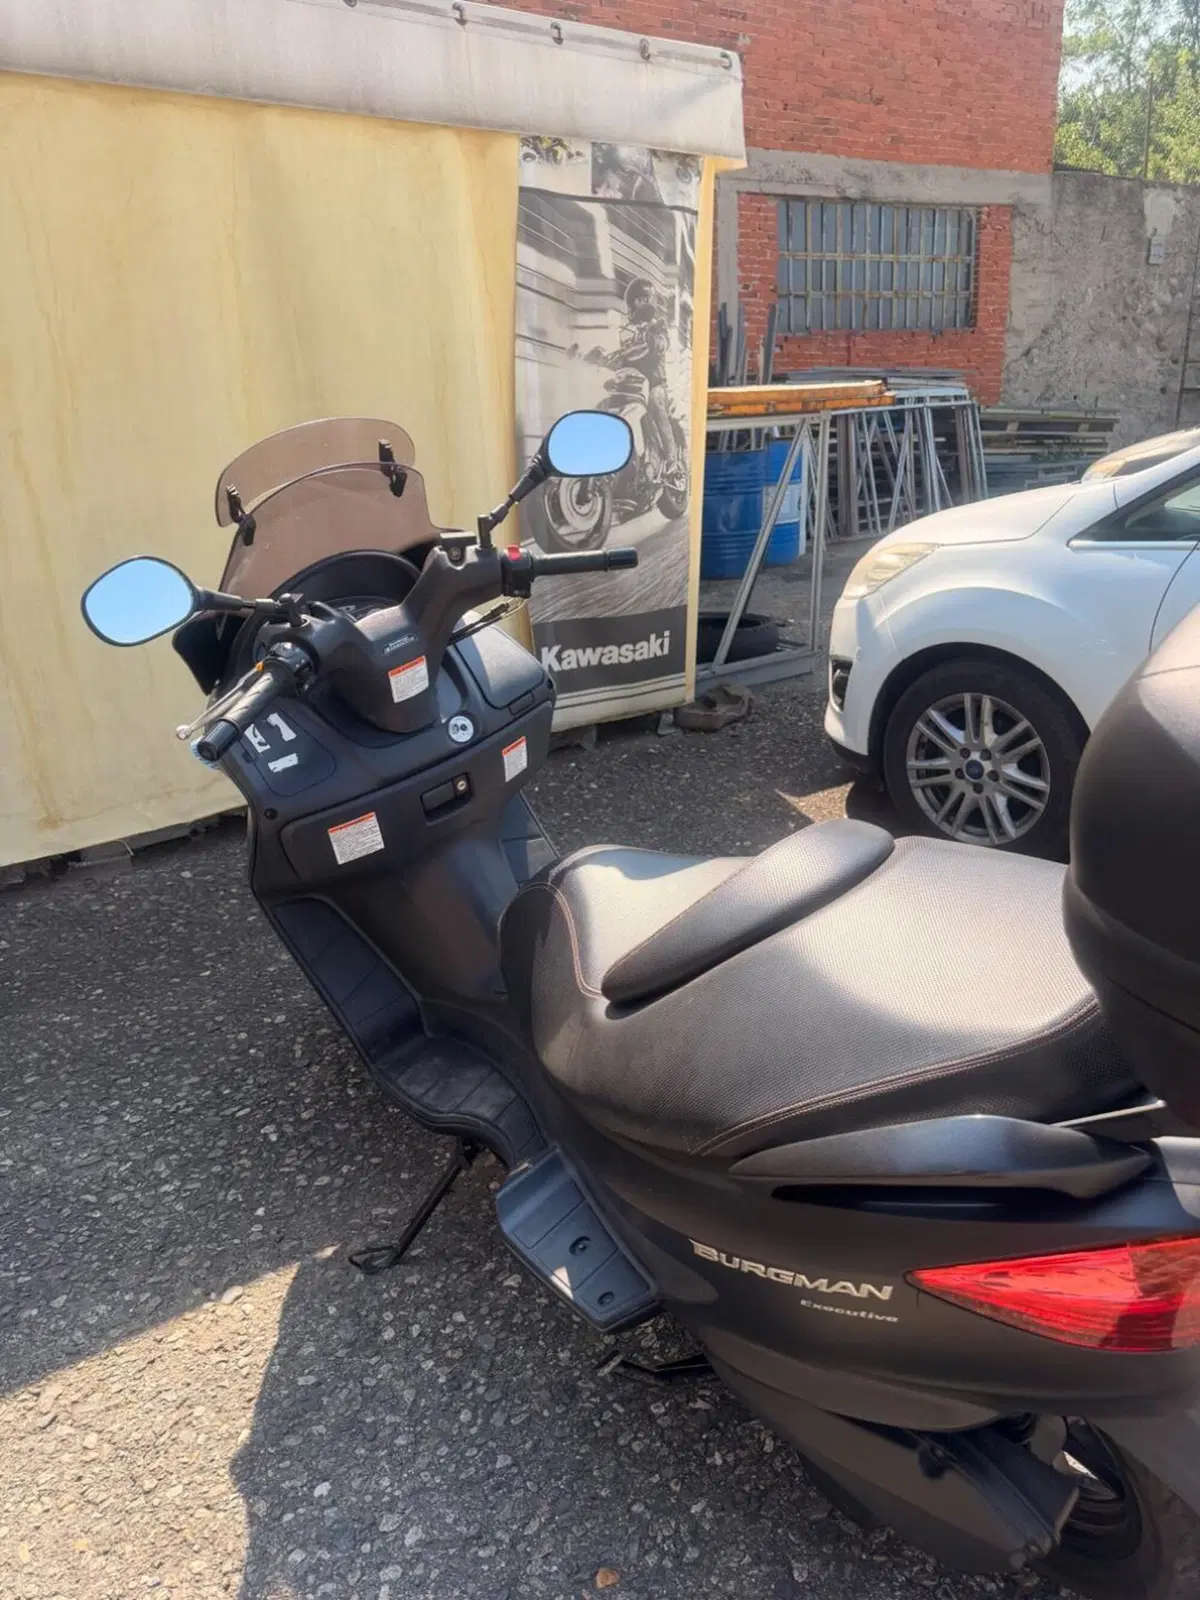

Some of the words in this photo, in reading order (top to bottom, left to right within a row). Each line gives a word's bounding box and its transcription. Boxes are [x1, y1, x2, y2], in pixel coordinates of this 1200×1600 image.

[541, 630, 670, 672] Kawasaki
[689, 1239, 894, 1300] BURGMAN
[800, 1299, 899, 1323] Executive
